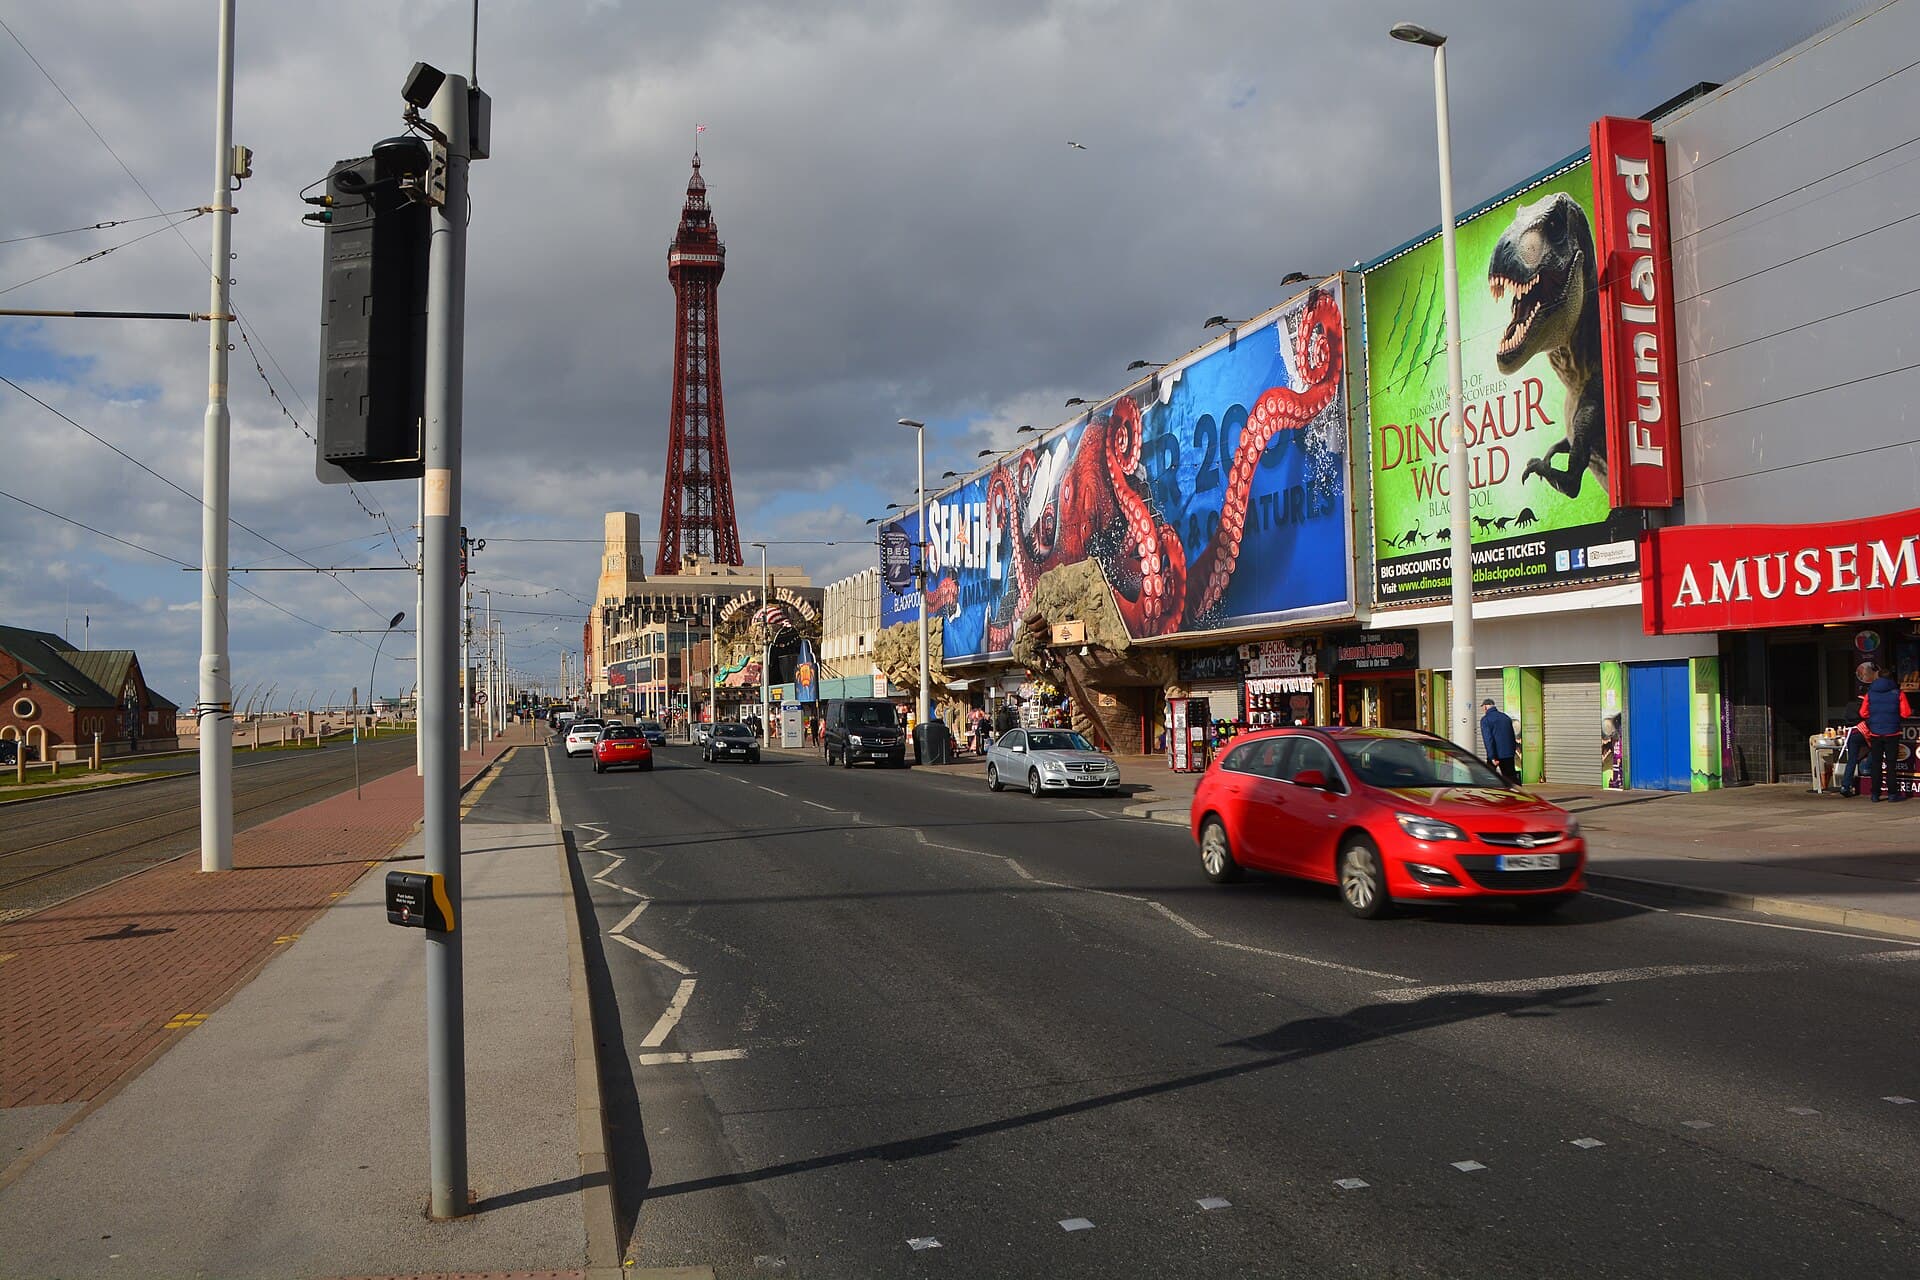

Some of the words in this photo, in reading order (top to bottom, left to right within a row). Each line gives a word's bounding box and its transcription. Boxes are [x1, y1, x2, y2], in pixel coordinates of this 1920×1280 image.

[1615, 155, 1664, 468] Funland
[1380, 565, 1394, 578] BIG
[1396, 557, 1441, 576] DISCOUNTS
[1506, 541, 1546, 560] TICKETS
[720, 590, 756, 621] CORAL
[775, 587, 815, 621] ISLAND
[1381, 582, 1397, 594] Visit
[1264, 654, 1296, 668] T-SHIRTS
